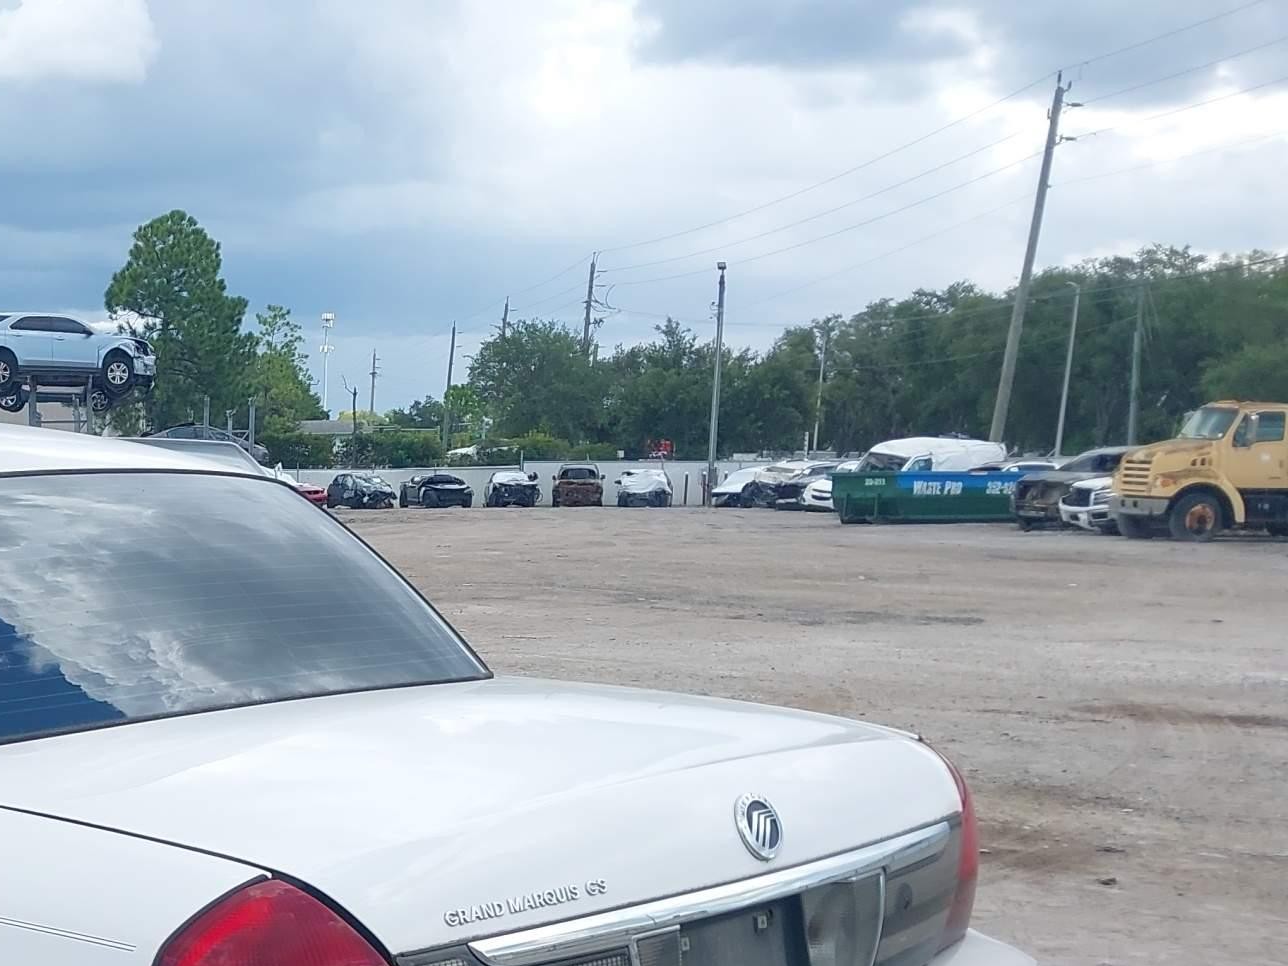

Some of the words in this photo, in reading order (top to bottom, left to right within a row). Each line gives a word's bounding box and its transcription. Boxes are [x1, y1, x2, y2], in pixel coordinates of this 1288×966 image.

[443, 901, 505, 927] GRAND
[507, 884, 580, 913] MARQUIS
[585, 877, 608, 896] GS
